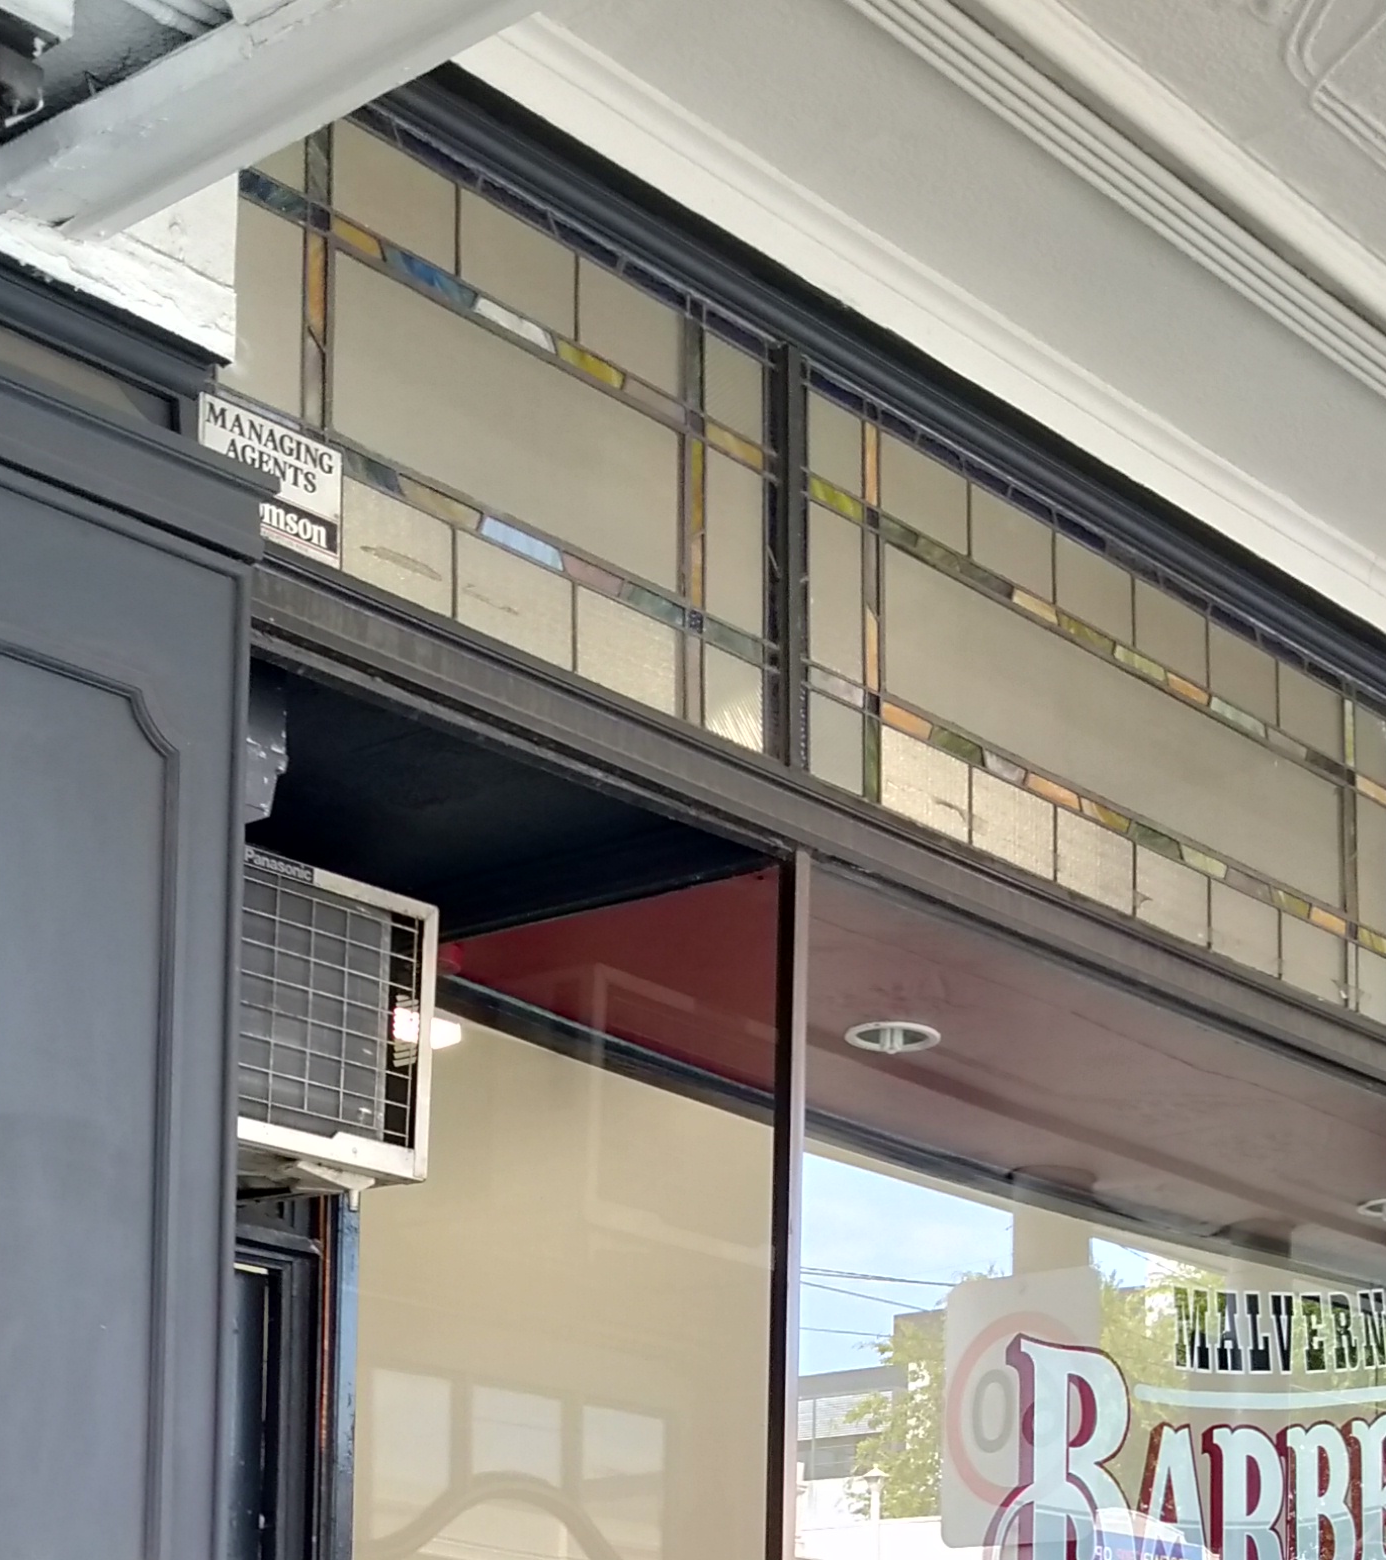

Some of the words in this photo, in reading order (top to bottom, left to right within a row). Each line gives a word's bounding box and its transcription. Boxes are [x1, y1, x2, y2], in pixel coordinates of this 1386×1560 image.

[205, 402, 334, 475] MANAGING
[226, 439, 318, 494] AGENTS
[245, 847, 312, 882] Panasonic
